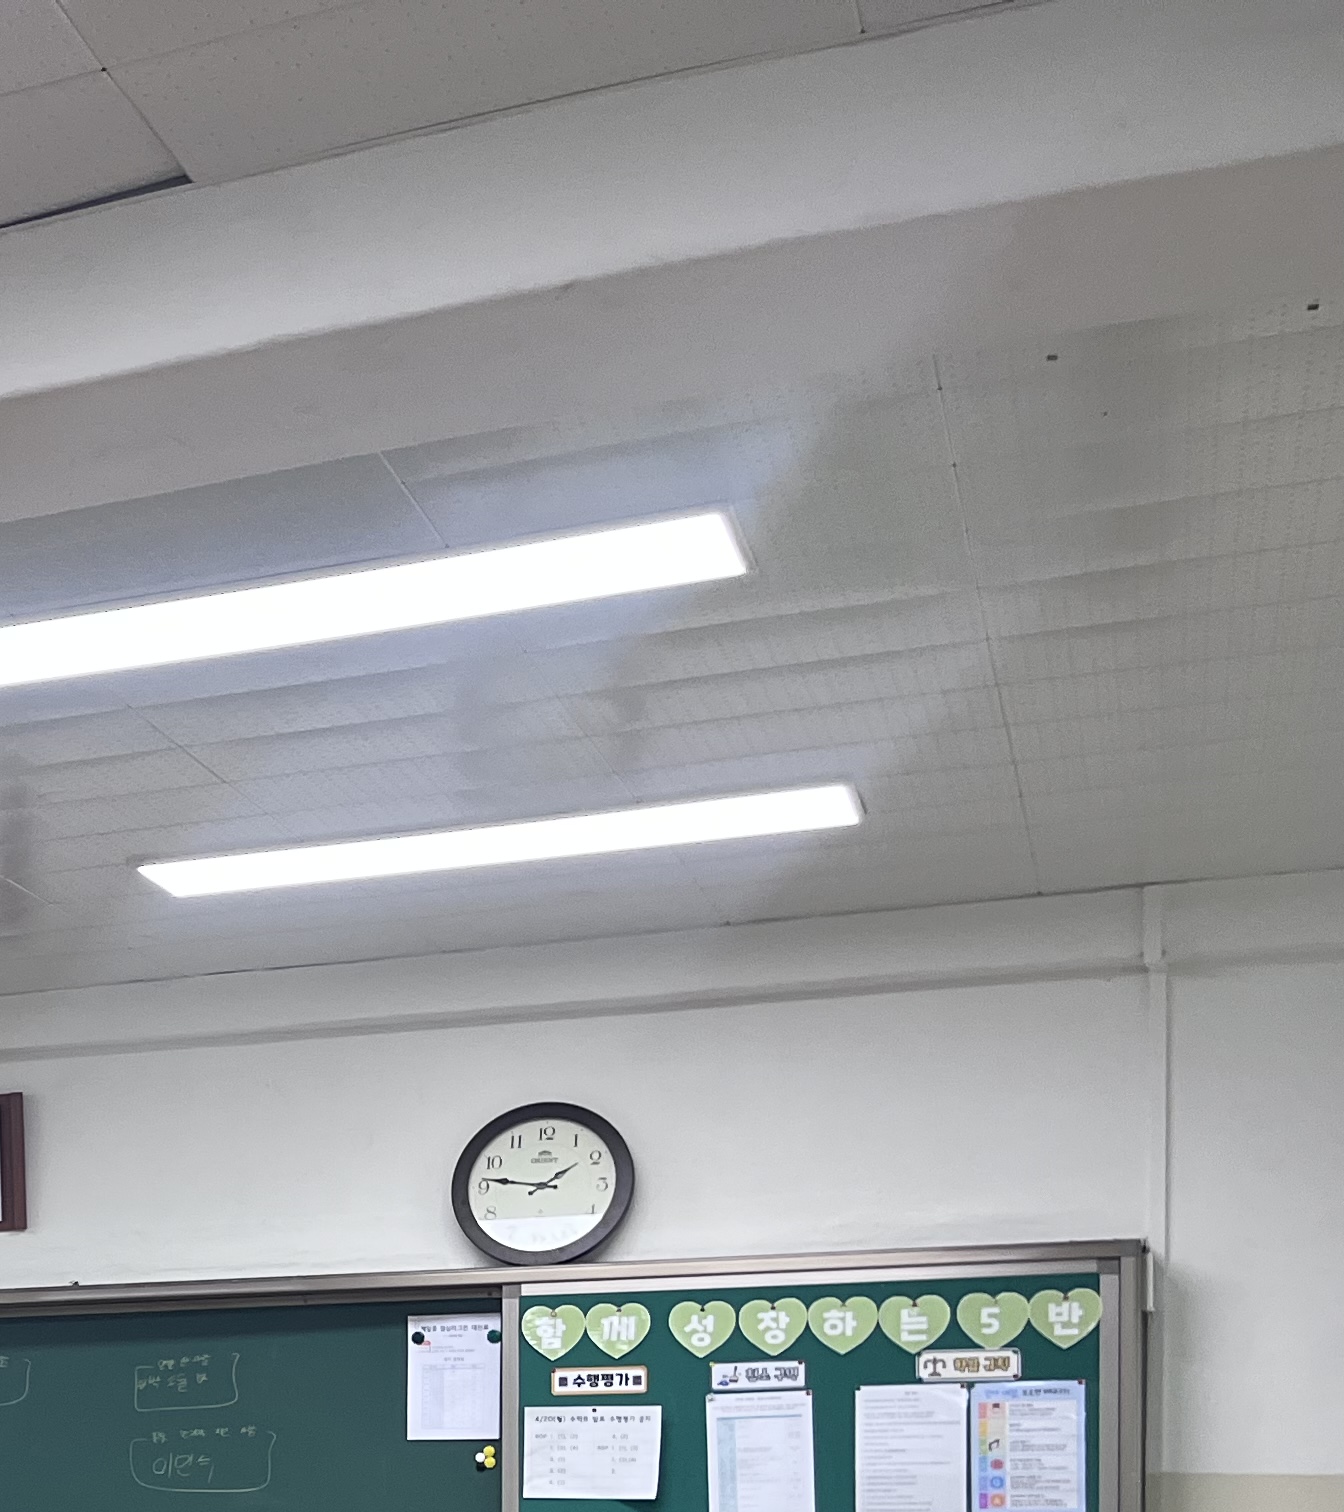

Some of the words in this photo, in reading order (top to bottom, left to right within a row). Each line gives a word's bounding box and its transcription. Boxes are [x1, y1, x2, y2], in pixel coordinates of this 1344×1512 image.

[538, 1126, 556, 1141] 12
[572, 1133, 579, 1148] 1
[510, 1135, 522, 1149] 11
[486, 1155, 503, 1170] 10
[589, 1150, 602, 1166] 2
[478, 1180, 490, 1195] 9
[596, 1177, 609, 1192] 3
[483, 1205, 497, 1220] 8
[535, 1314, 637, 1349] 함께
[683, 1306, 929, 1347] 성장하는
[981, 1301, 1084, 1336] 5반
[572, 1372, 630, 1389] 수행평가
